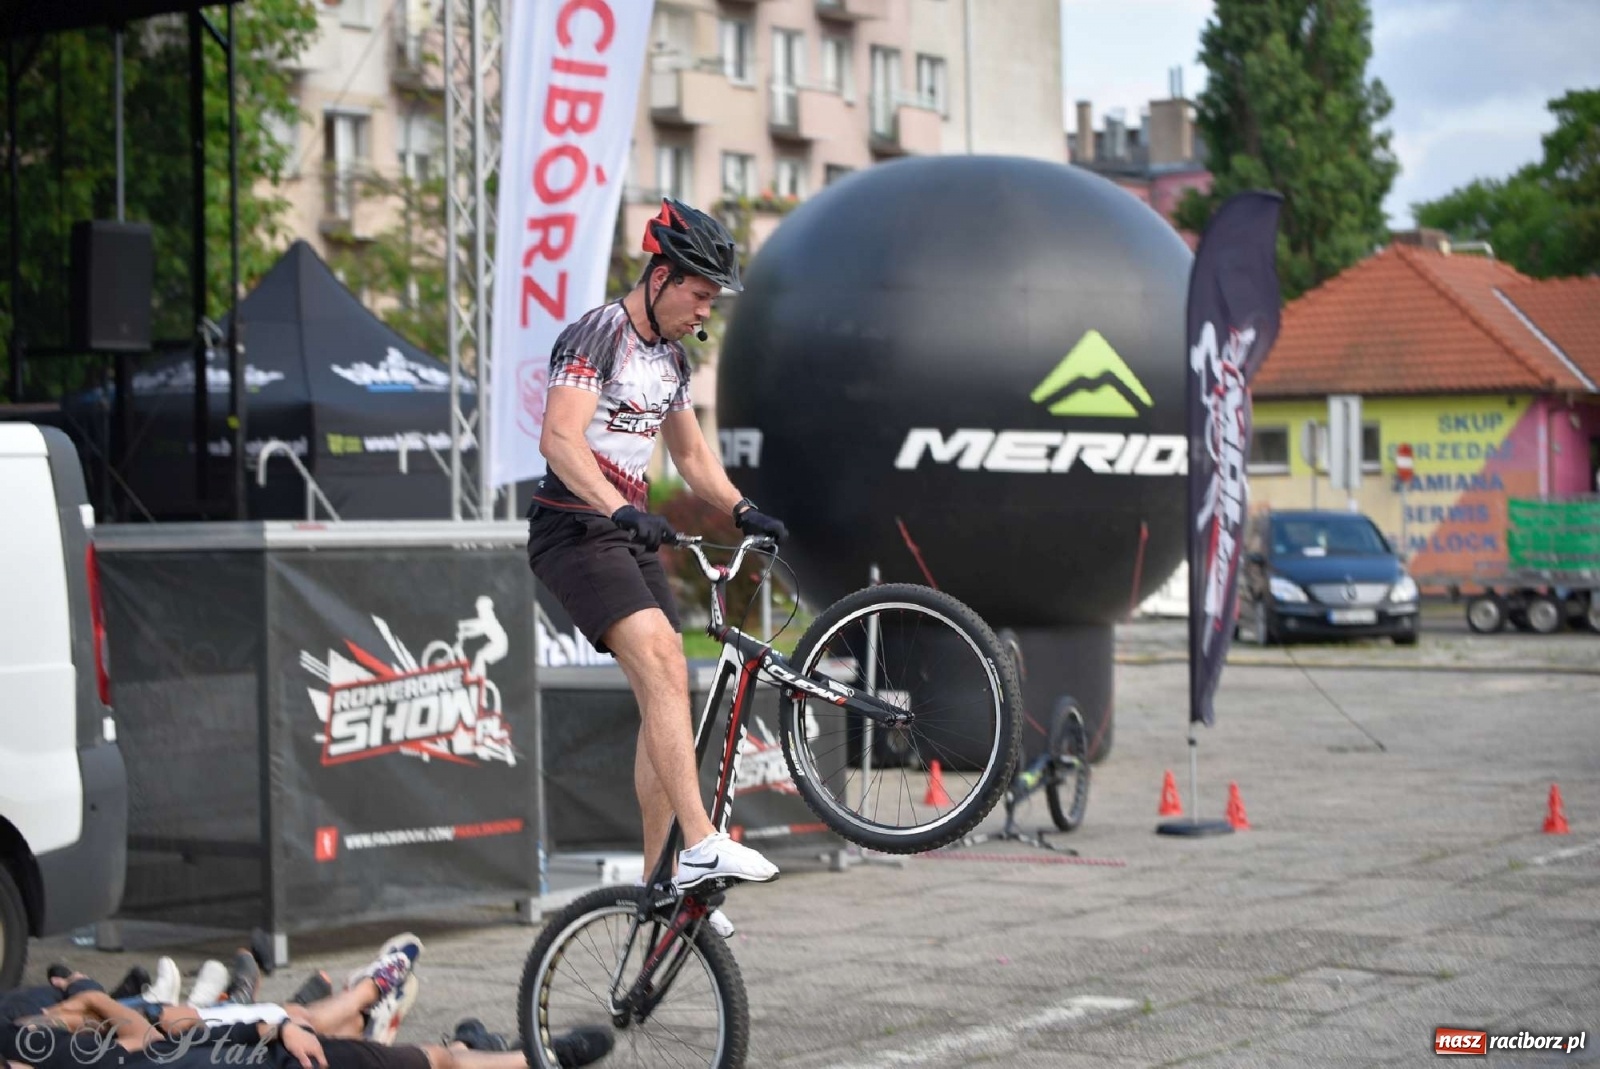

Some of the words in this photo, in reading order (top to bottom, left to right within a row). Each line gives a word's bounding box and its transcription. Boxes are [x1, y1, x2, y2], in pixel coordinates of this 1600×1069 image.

[1438, 410, 1504, 433] SKUP
[894, 428, 1189, 475] MERID
[328, 682, 480, 756] SHOW
